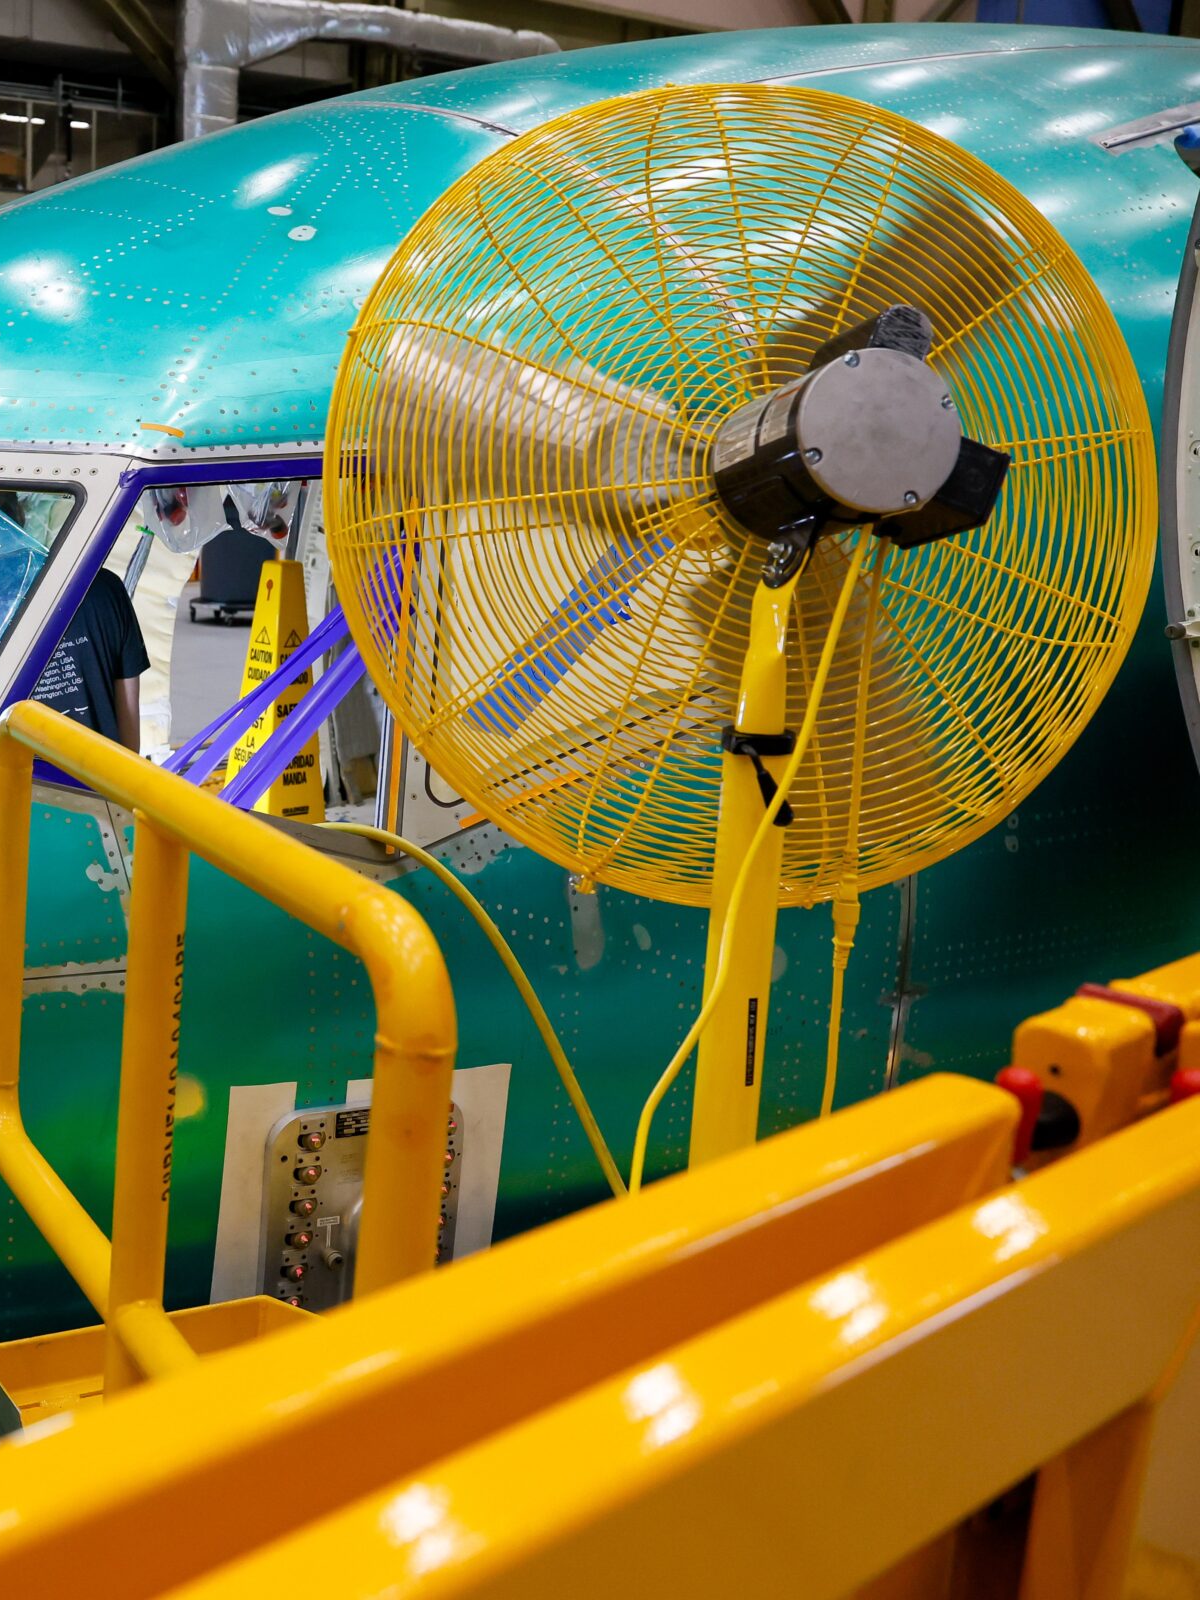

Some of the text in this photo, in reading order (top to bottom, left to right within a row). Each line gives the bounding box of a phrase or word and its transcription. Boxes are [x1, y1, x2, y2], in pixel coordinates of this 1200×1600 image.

[76, 636, 88, 644] USA
[60, 656, 74, 665] USA
[250, 648, 273, 664] CAUTION
[62, 663, 76, 672] USA
[62, 671, 76, 680] USA
[246, 735, 255, 749] LA
[282, 772, 307, 786] MANDA
